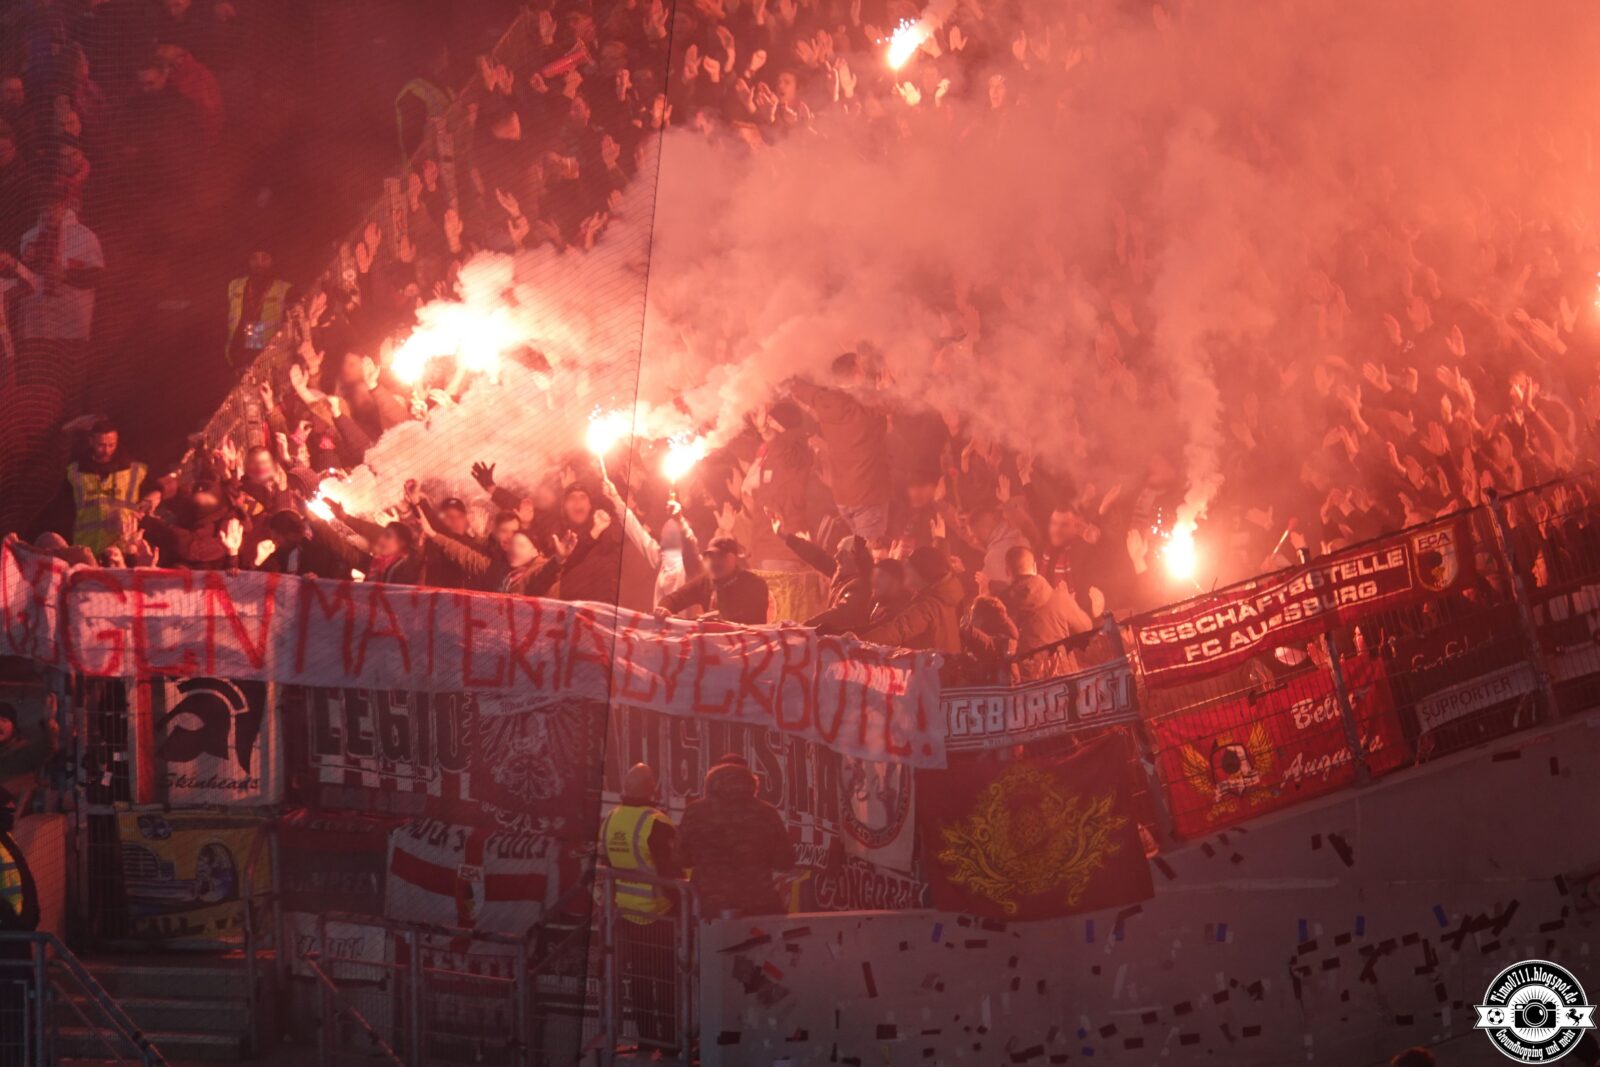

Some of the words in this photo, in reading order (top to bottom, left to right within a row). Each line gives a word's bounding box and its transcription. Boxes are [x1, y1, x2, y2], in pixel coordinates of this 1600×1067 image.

[1183, 642, 1223, 662] FC
[1077, 670, 1132, 719] OST
[1421, 675, 1513, 717] SUPPORTER
[158, 772, 259, 790] Skinheads
[1280, 735, 1384, 788] Augua
